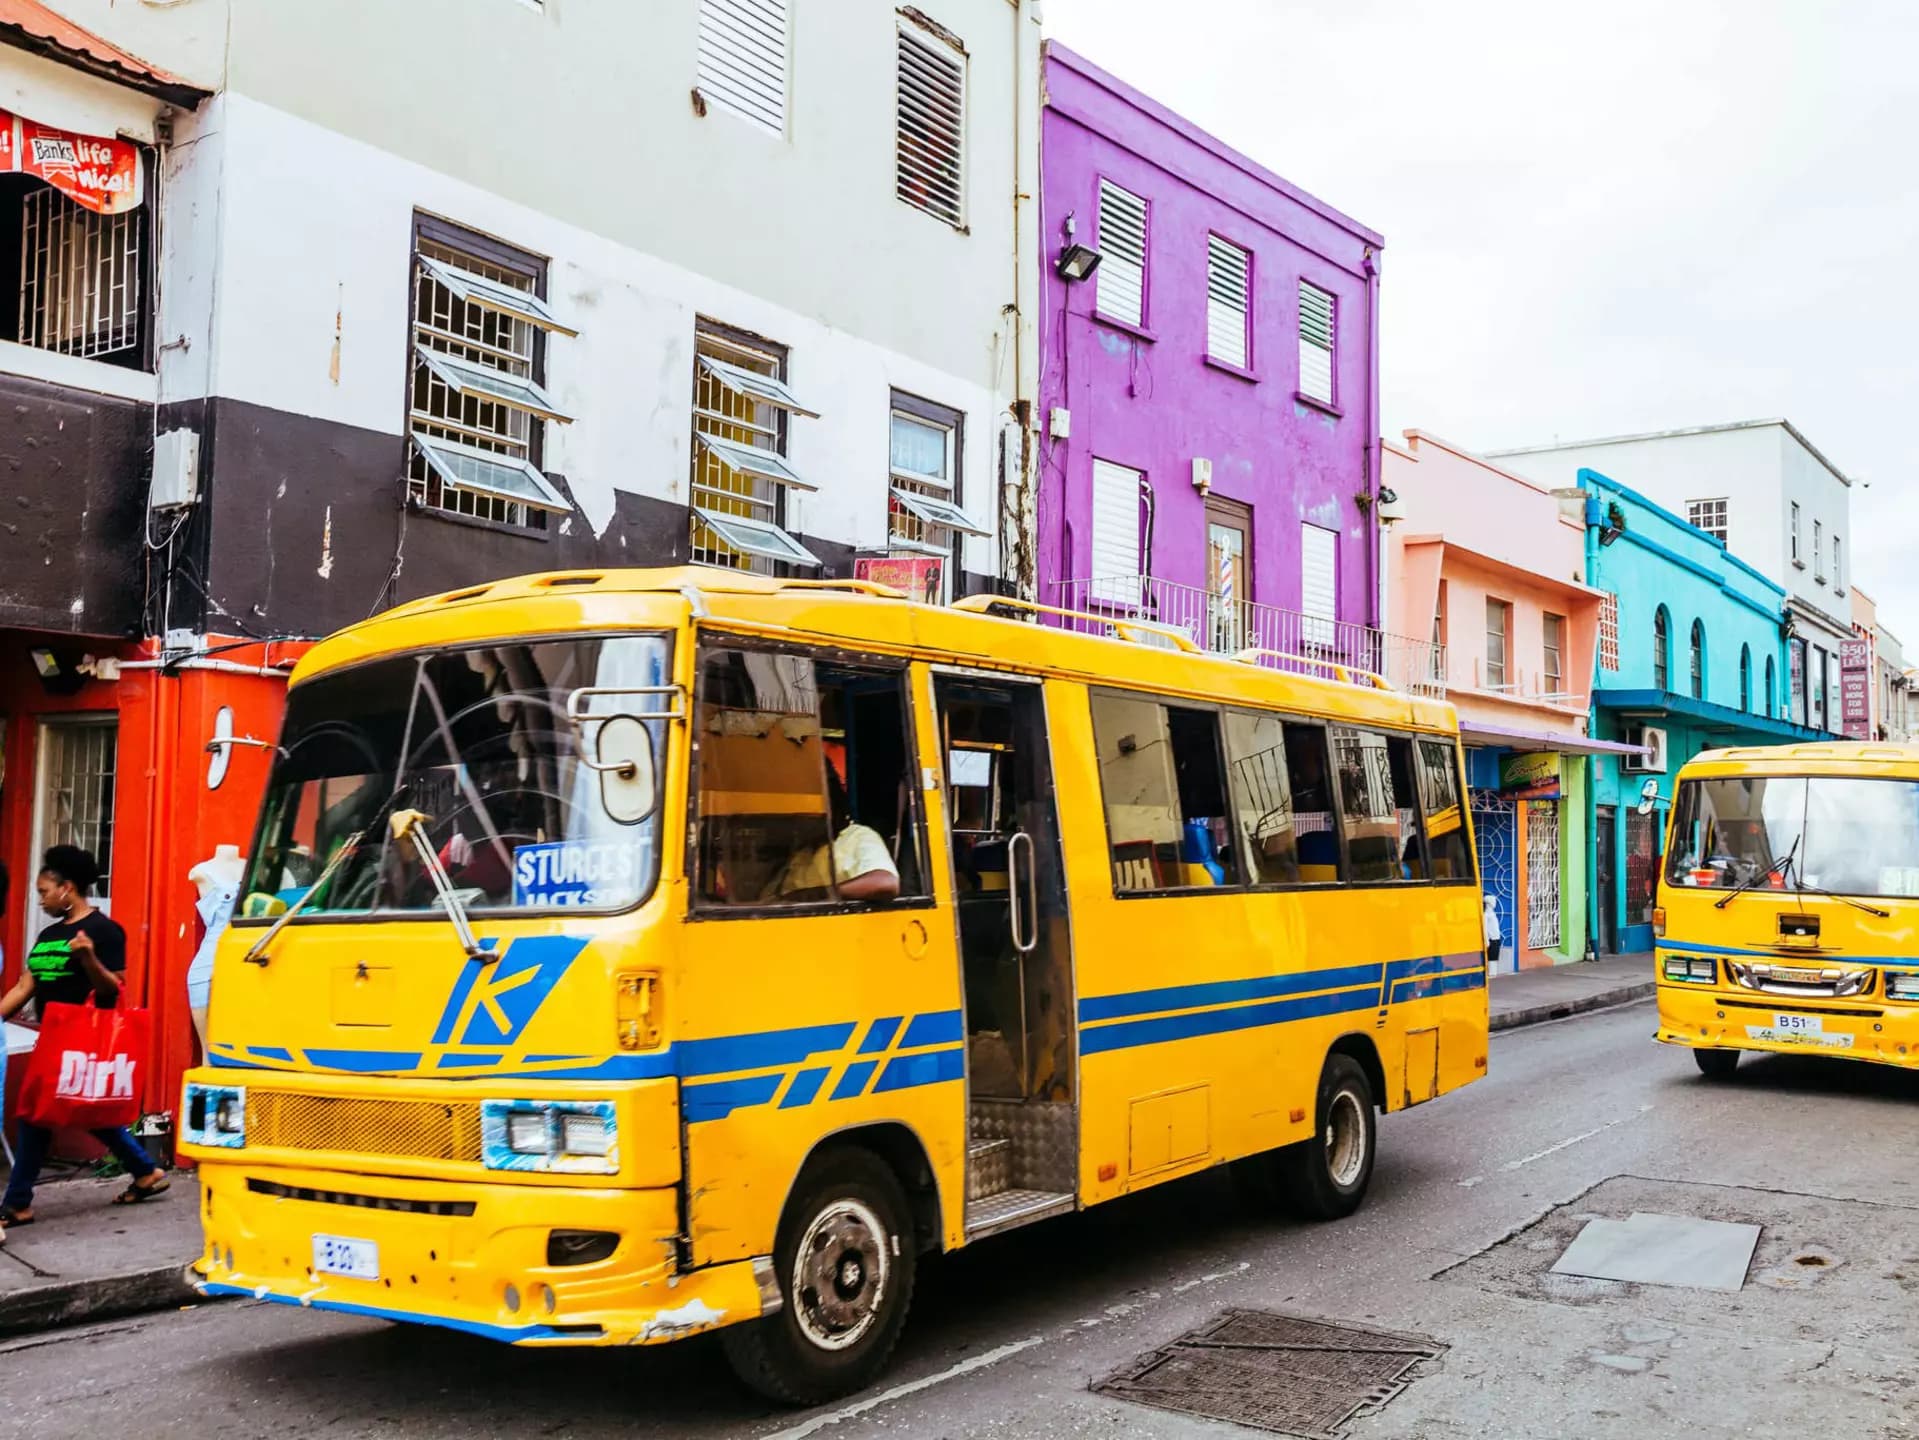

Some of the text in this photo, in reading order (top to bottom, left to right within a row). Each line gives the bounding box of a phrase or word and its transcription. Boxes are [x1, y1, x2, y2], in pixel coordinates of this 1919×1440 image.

[34, 140, 75, 162] Banks
[77, 139, 113, 166] life
[57, 1050, 137, 1098] Dirk
